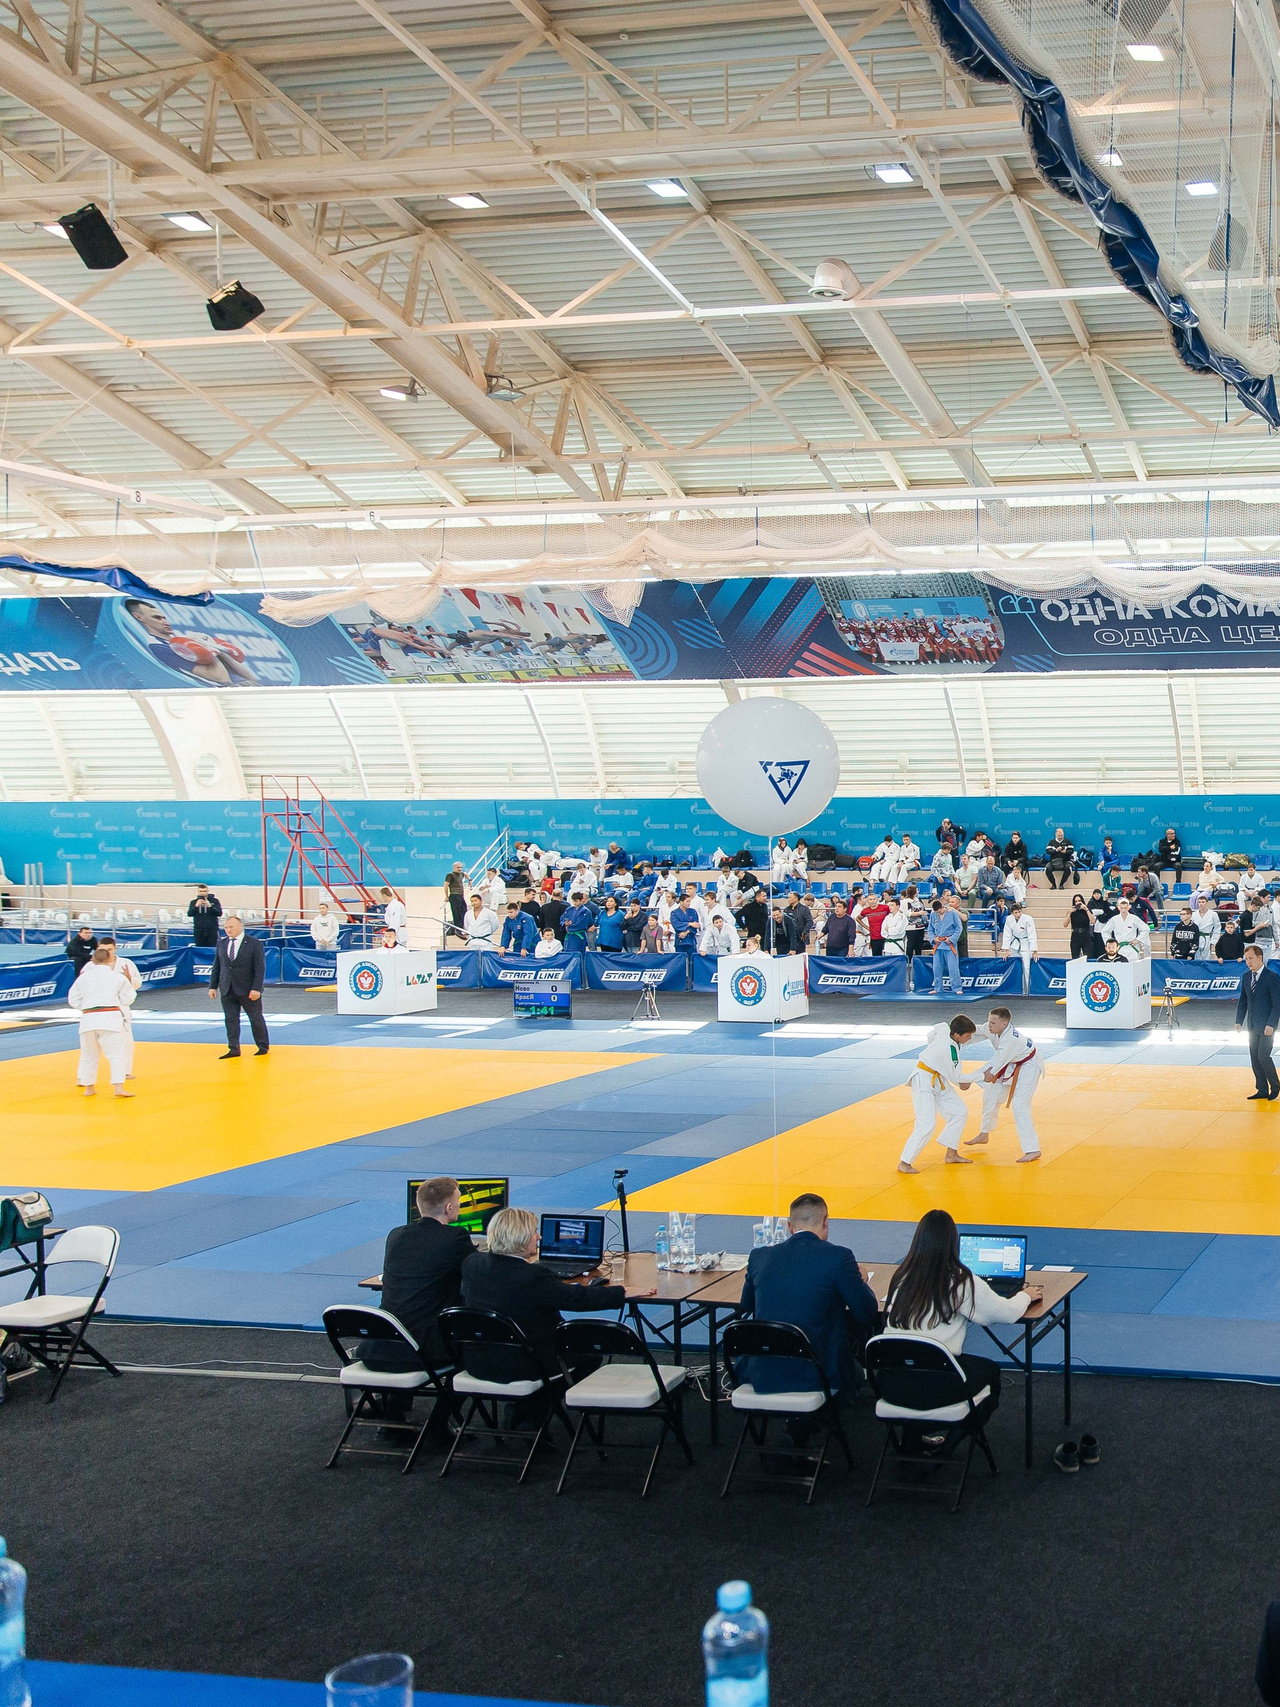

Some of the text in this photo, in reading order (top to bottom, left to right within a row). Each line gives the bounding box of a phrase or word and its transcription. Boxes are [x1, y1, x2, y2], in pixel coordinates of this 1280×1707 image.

[134, 491, 142, 503] 8
[368, 511, 376, 523] 6
[1040, 596, 1149, 626] ОДНА
[1093, 626, 1211, 647] ОДНА
[152, 968, 176, 979] LINE
[301, 968, 334, 977] START
[438, 970, 459, 978] LINE
[501, 972, 534, 980] START
[604, 972, 640, 980] START
[821, 976, 884, 984] START LINE
[978, 977, 1001, 986] LINE
[1170, 981, 1237, 989] START LINE
[32, 985, 54, 996] LINE
[550, 994, 558, 1002] 0
[529, 1006, 555, 1014] 1:41
